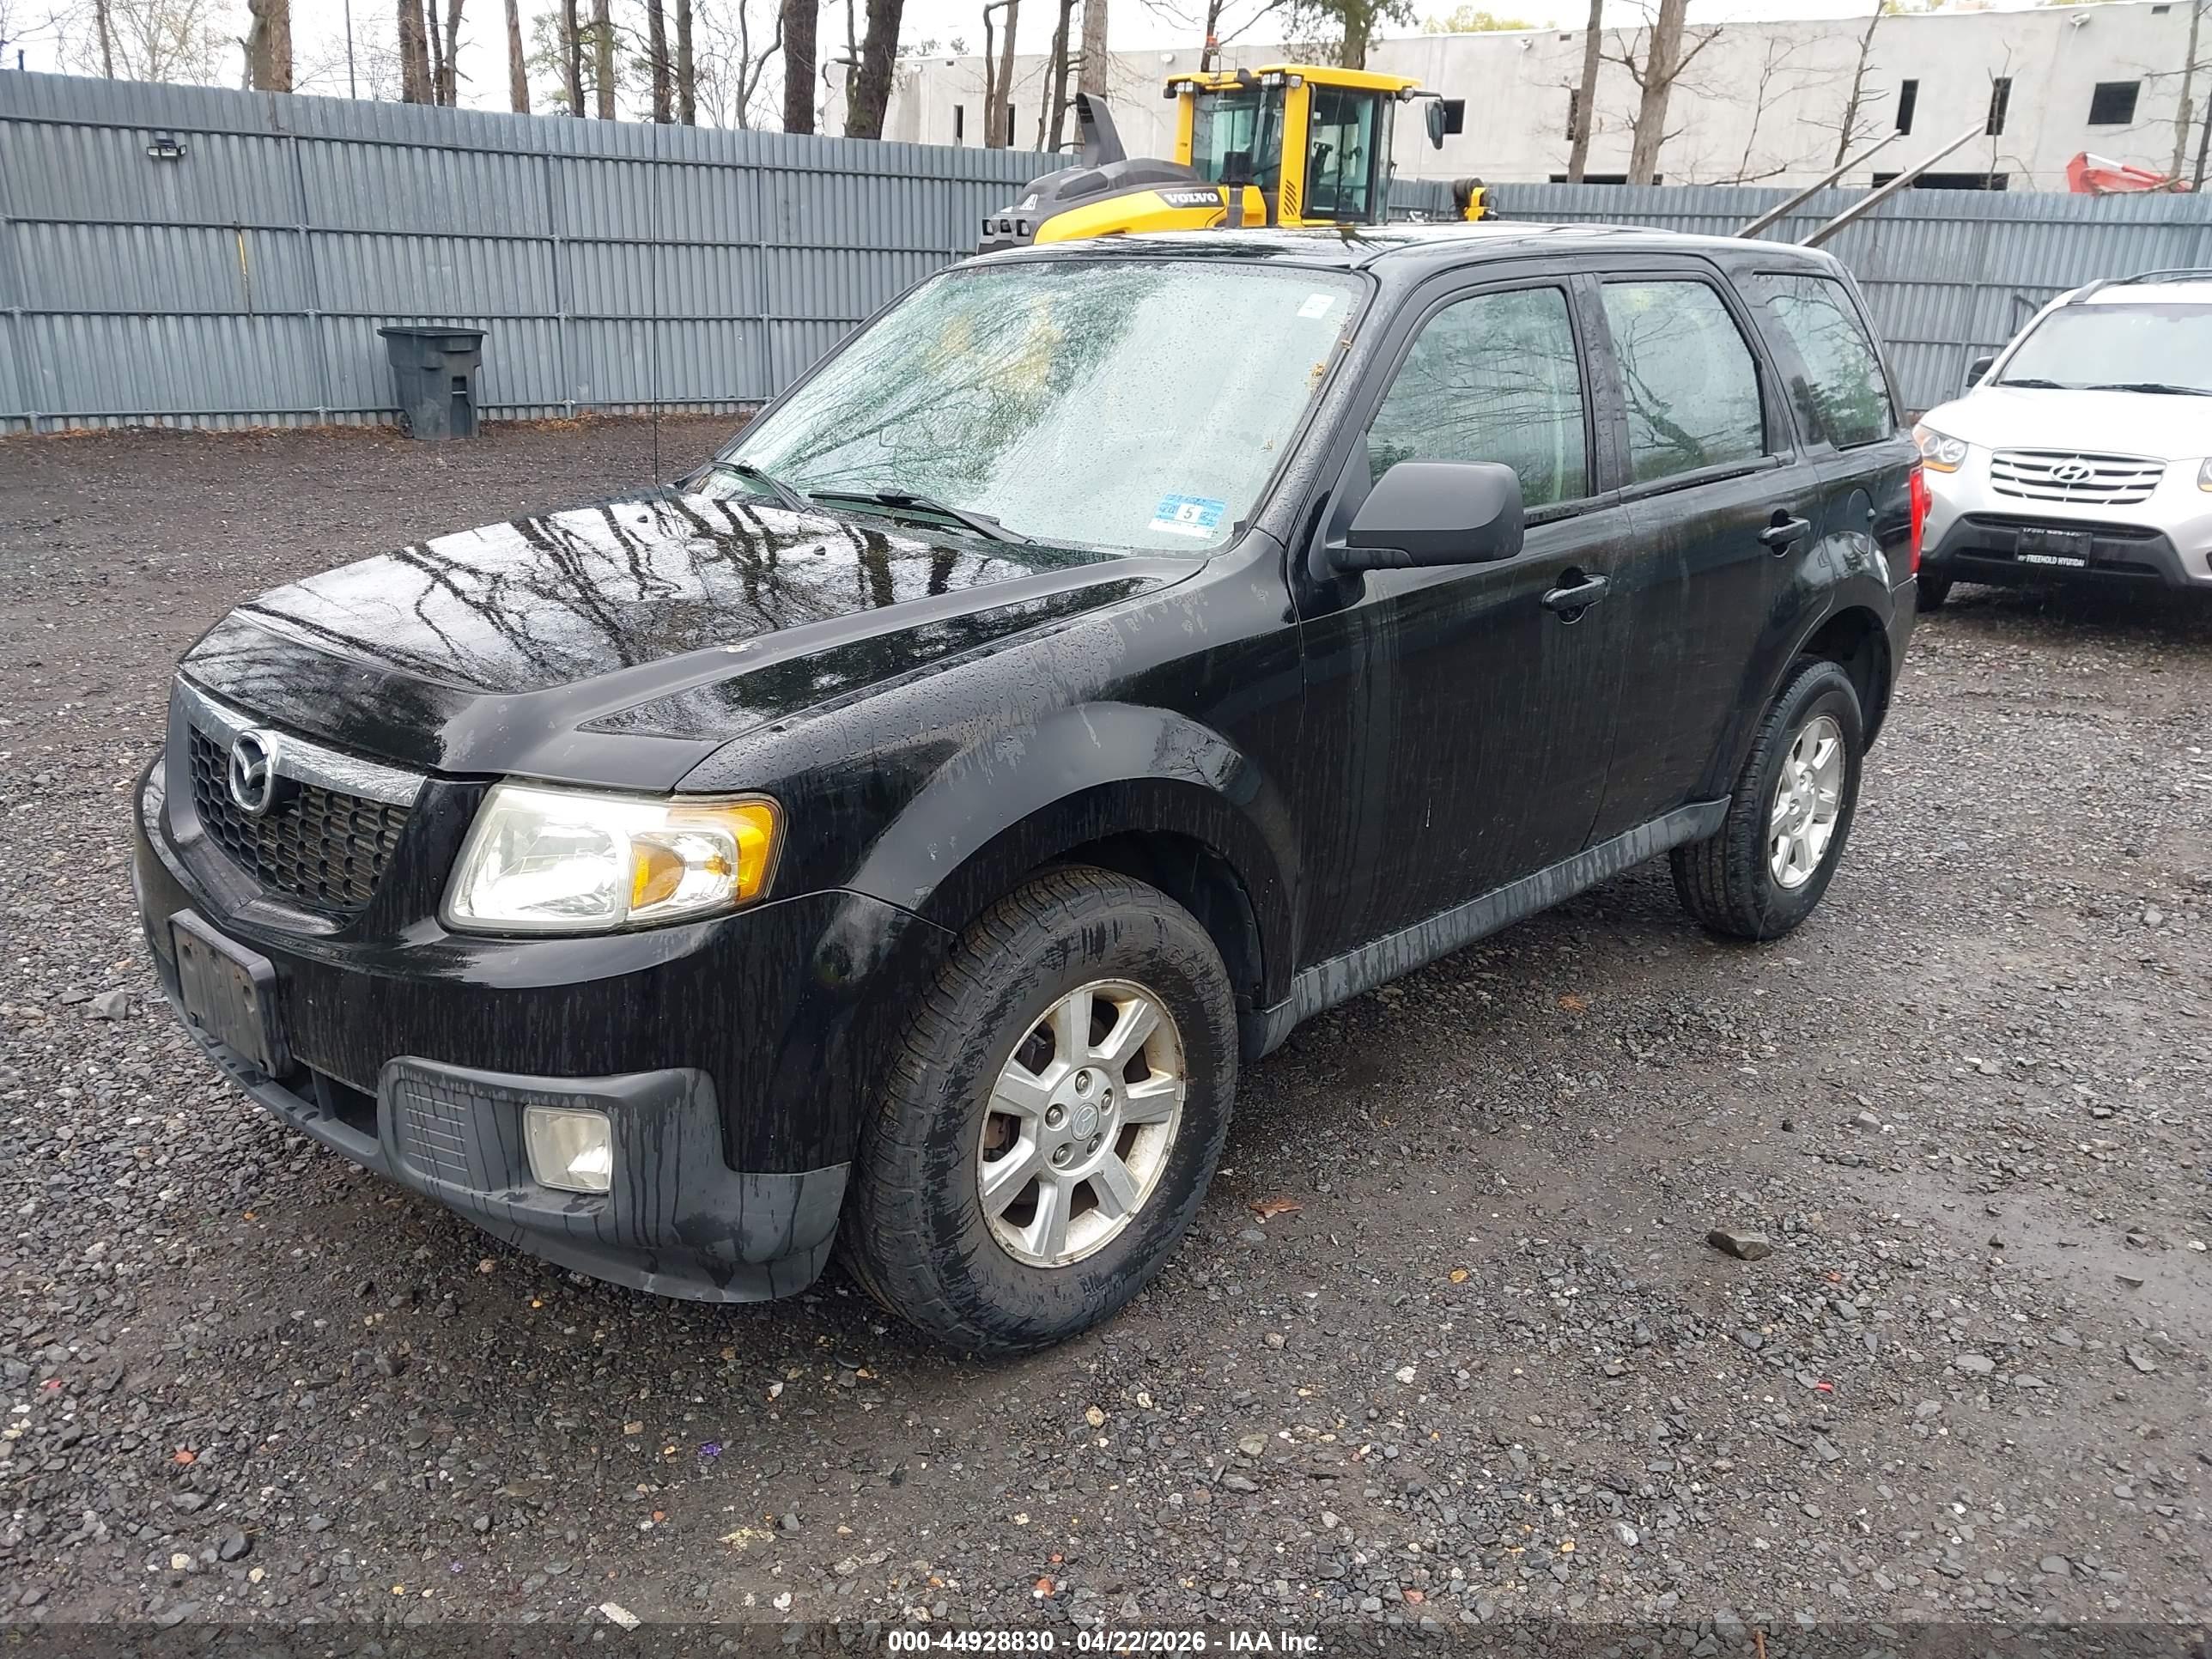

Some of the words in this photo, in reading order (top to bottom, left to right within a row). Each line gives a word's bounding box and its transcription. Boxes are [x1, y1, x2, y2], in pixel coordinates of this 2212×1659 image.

[1164, 192, 1218, 204] VOLVO
[1183, 506, 1195, 520] 5
[2027, 554, 2057, 564] FREEHOLD
[2057, 556, 2085, 567] HYUNDAI
